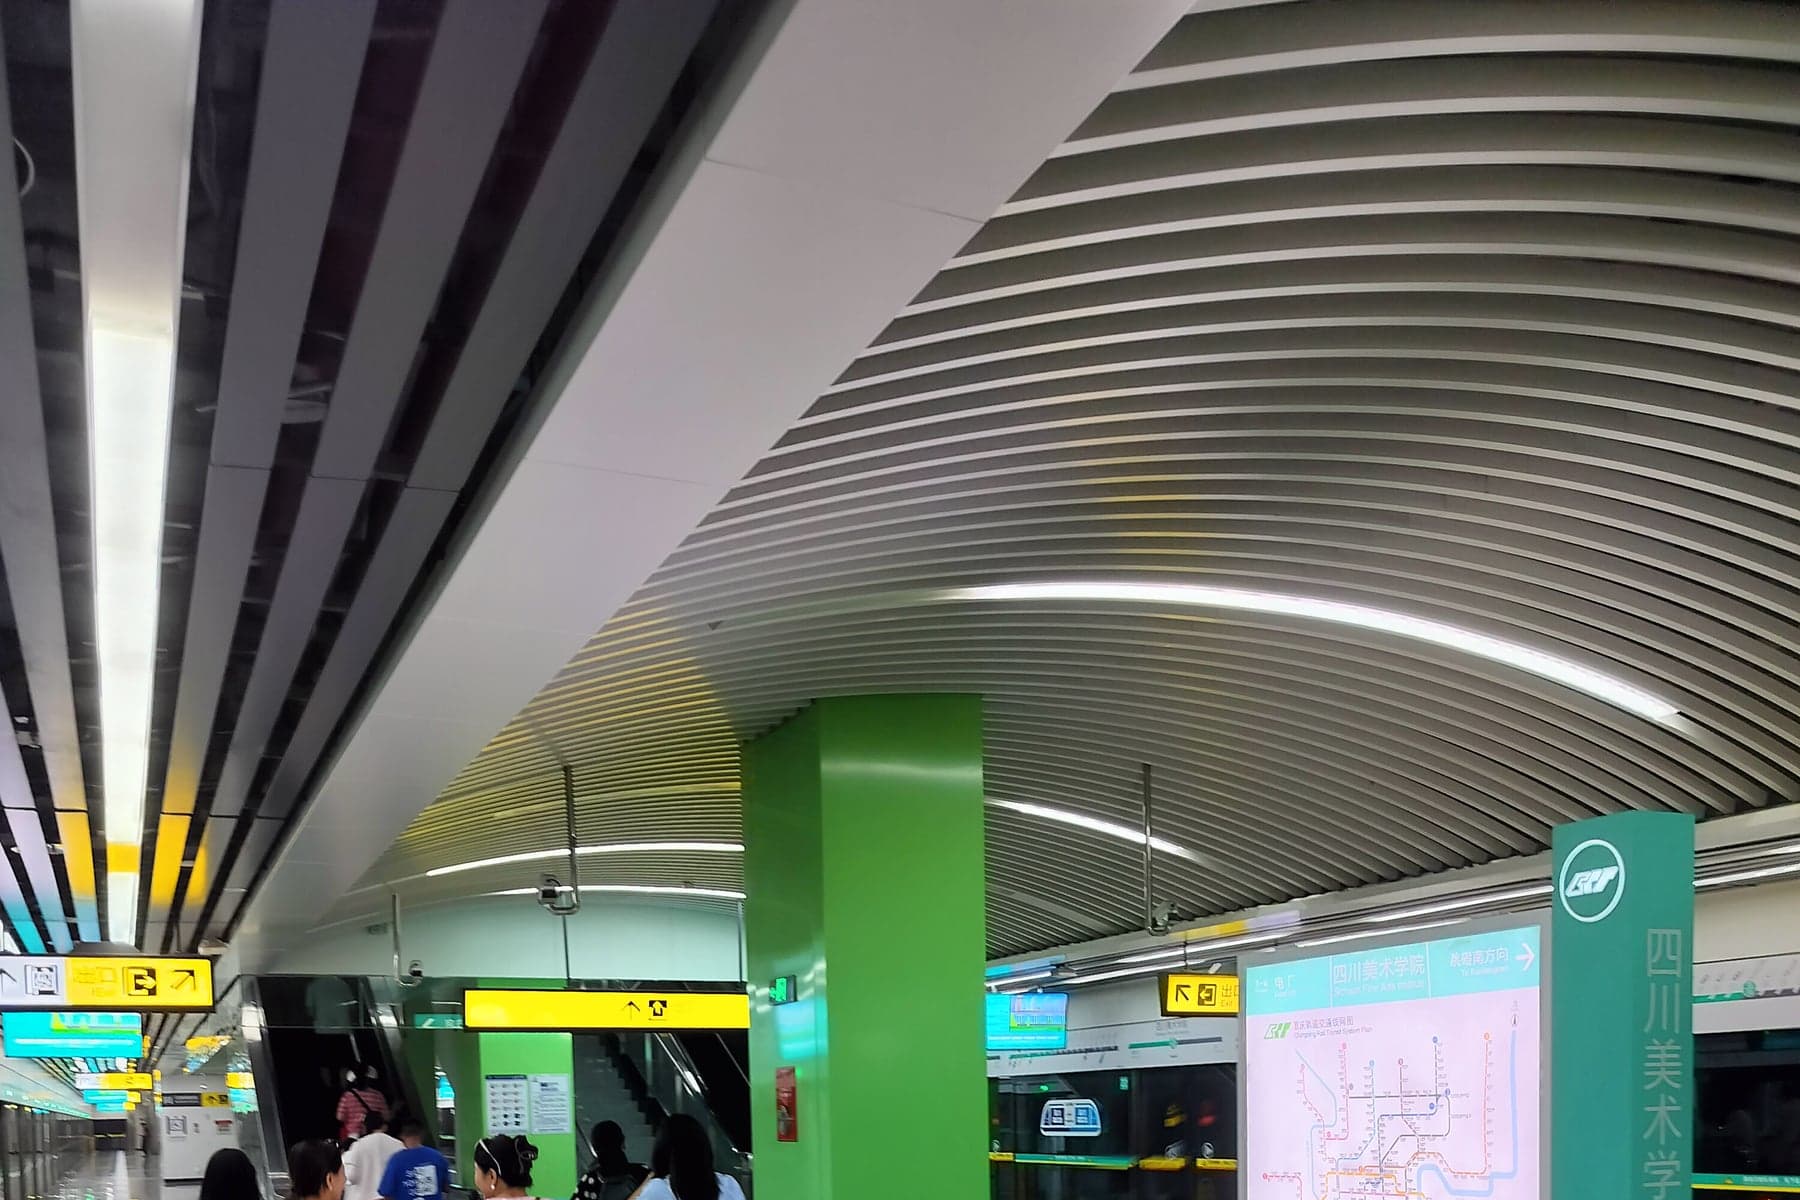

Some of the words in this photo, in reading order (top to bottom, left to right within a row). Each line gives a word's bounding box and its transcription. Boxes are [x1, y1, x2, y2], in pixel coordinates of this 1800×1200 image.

[1333, 954, 1425, 985] 四川美术学院
